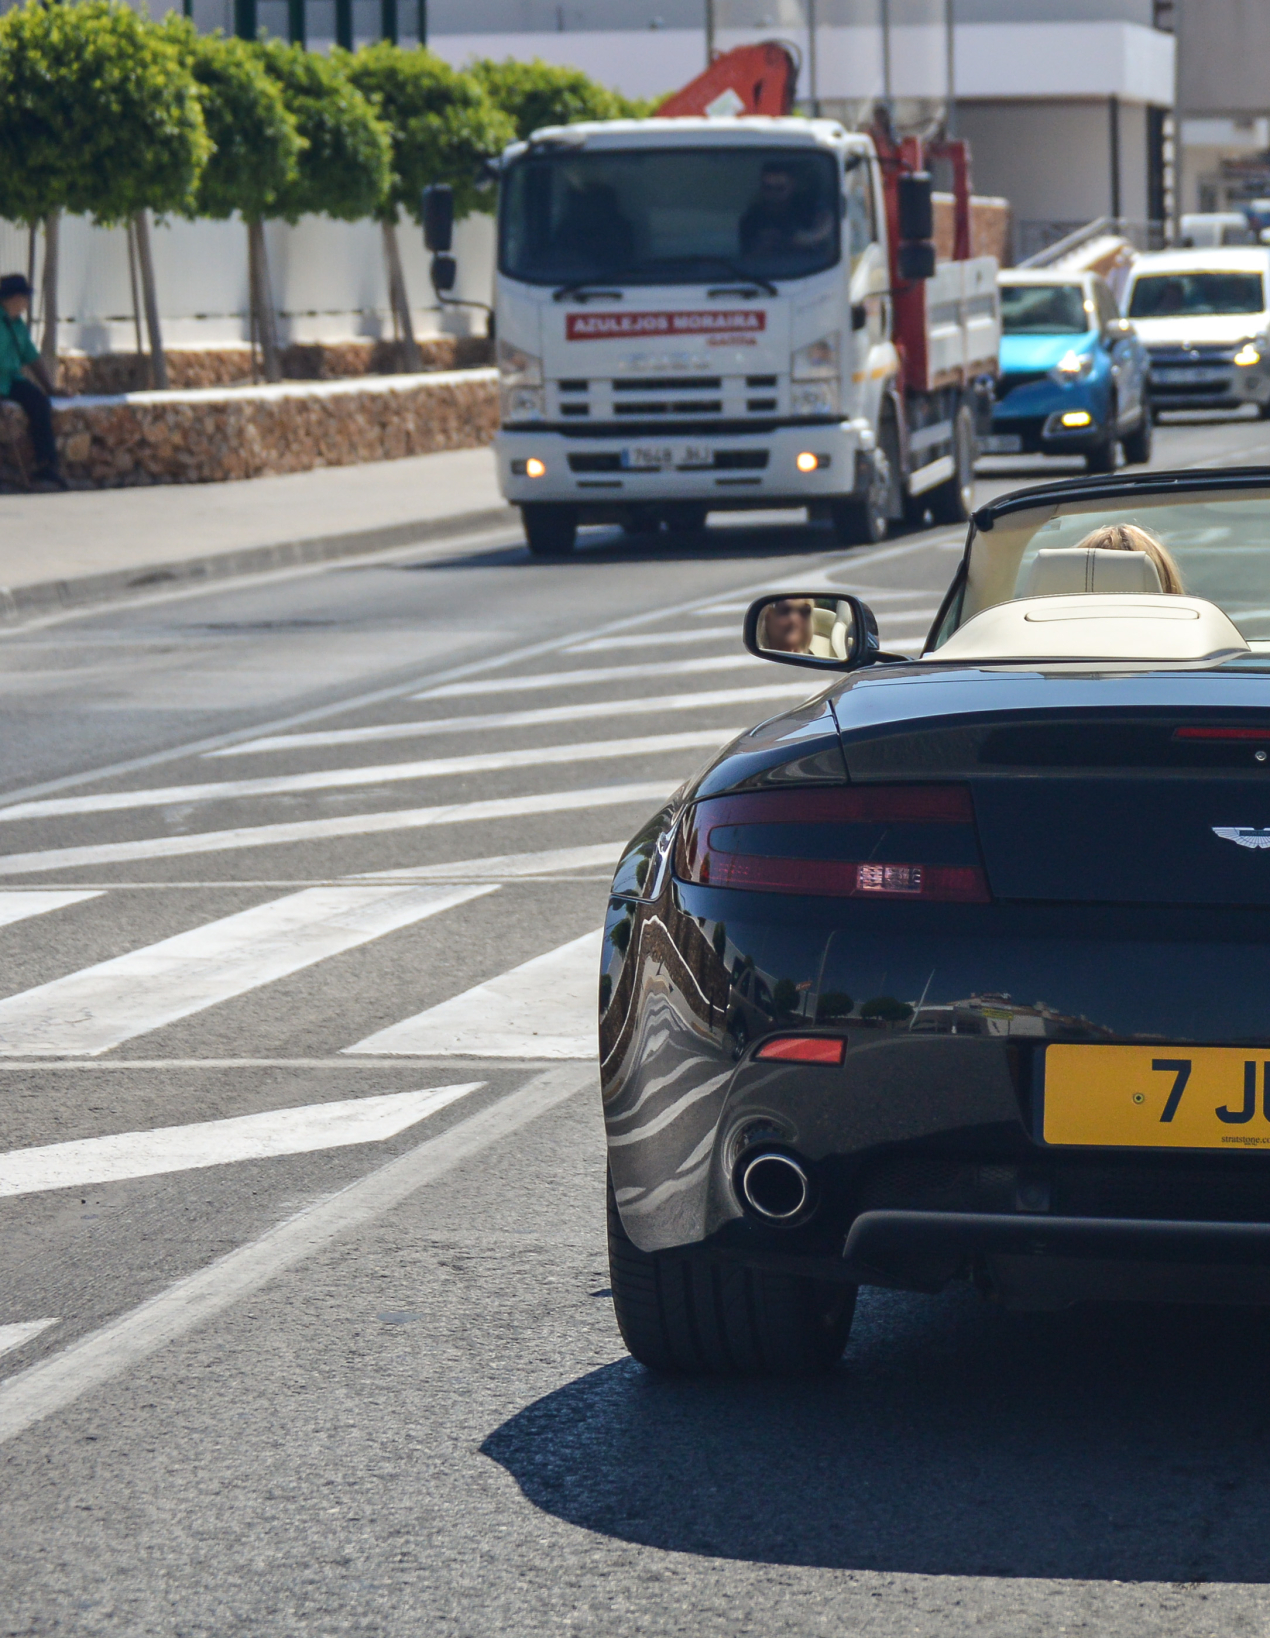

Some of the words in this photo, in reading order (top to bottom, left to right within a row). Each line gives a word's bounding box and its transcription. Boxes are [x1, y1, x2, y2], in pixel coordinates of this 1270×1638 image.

[573, 315, 669, 332] AZULEJOS
[673, 313, 760, 329] MORAIRA
[1152, 1058, 1192, 1123] 7
